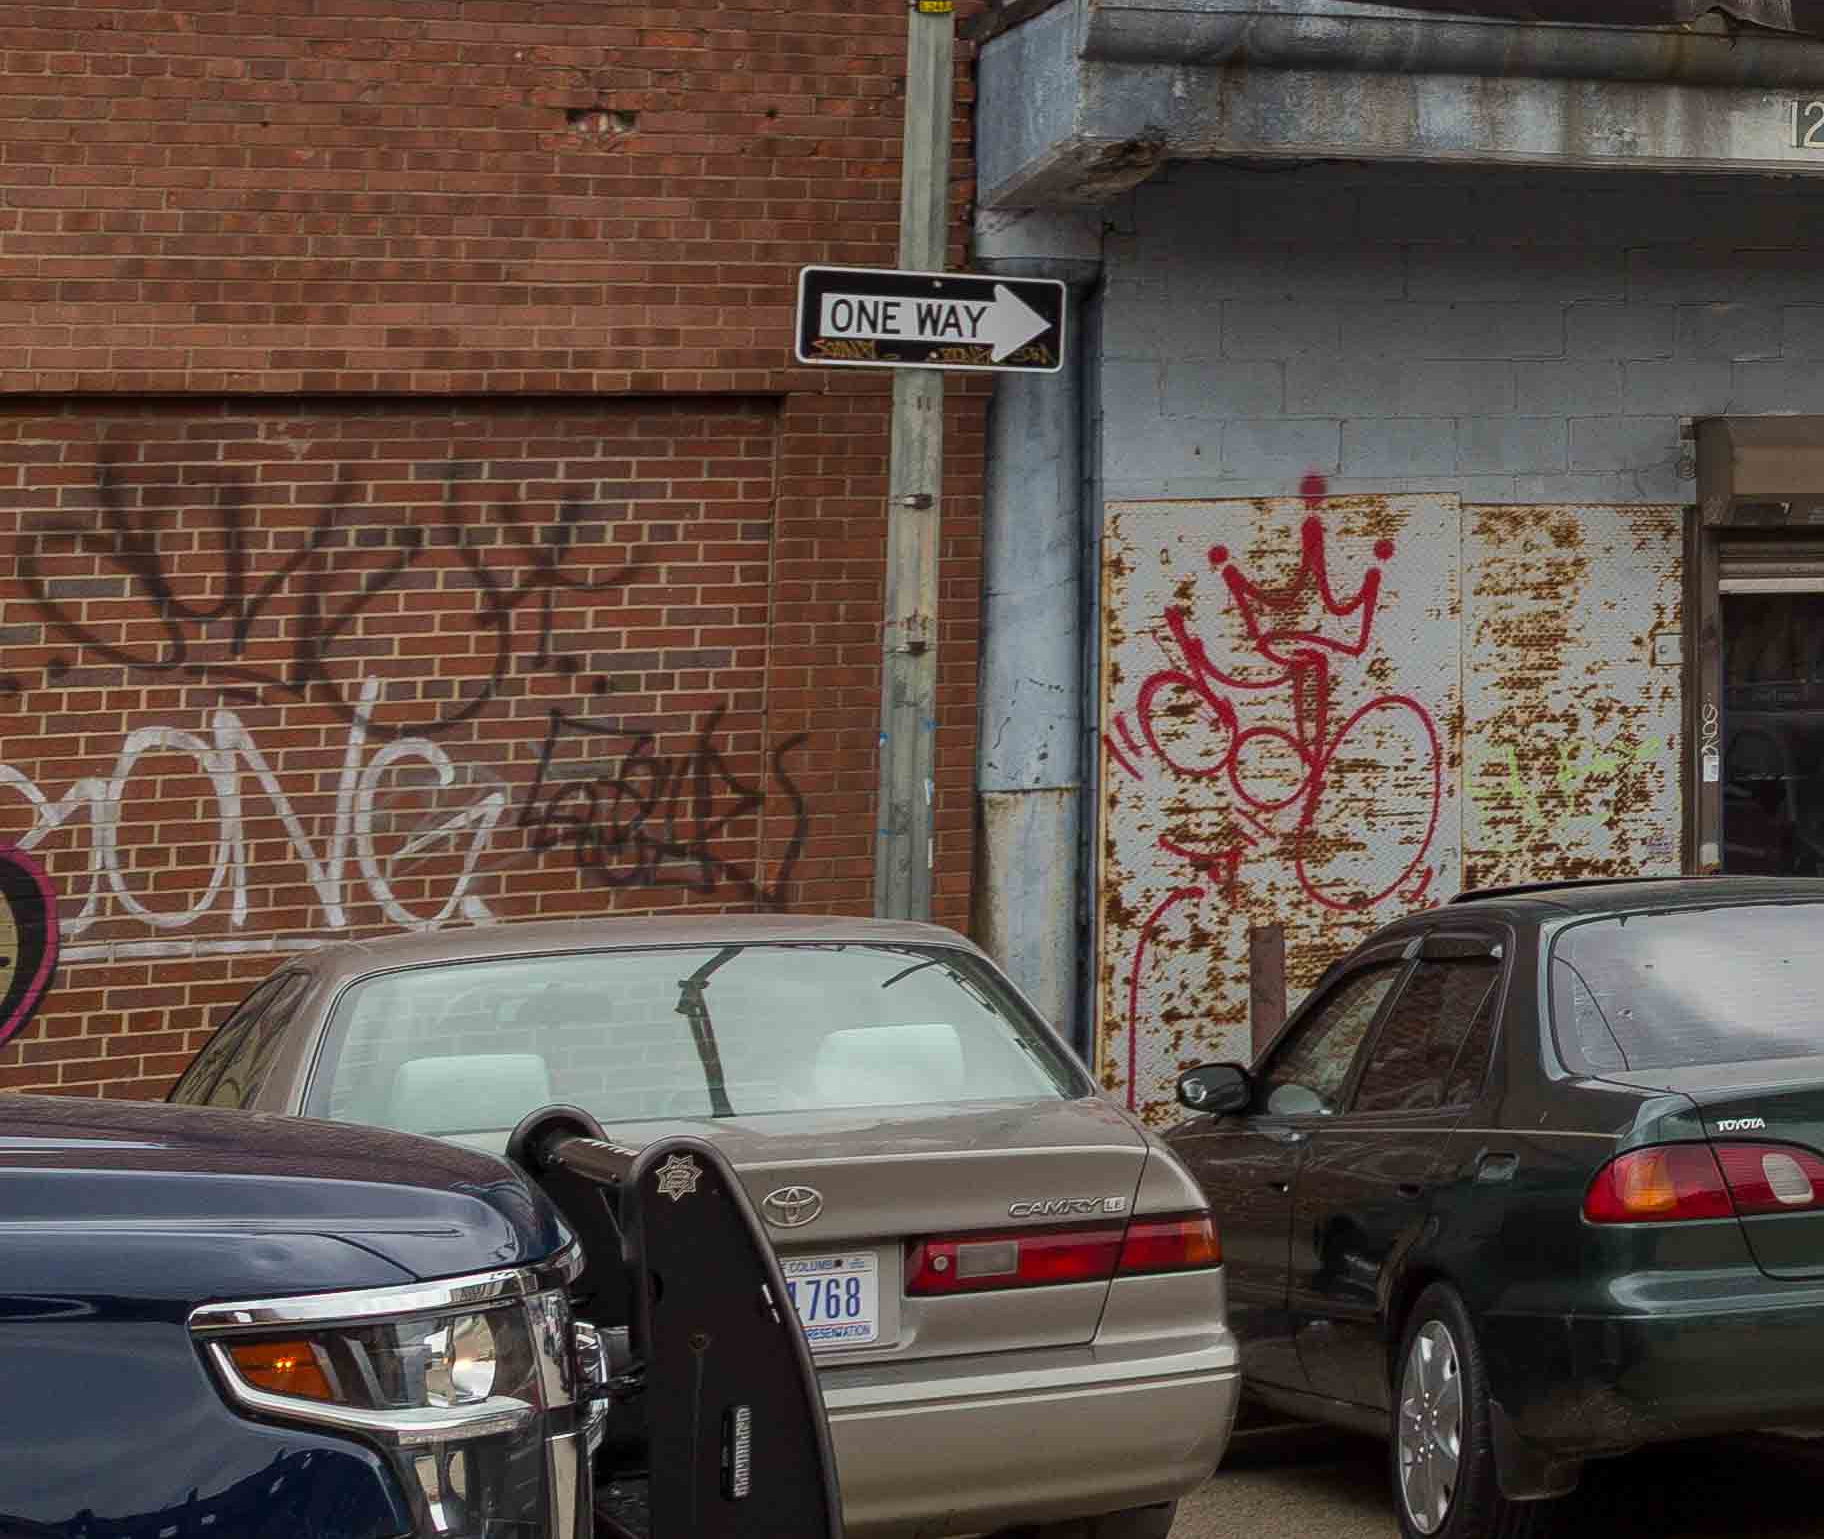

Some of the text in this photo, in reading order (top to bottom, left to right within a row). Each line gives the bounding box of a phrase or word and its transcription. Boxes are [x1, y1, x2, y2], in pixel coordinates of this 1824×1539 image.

[831, 299, 988, 338] ONE WAY
[1716, 1117, 1766, 1132] TOYOTA
[1008, 1197, 1104, 1218] CAMRY
